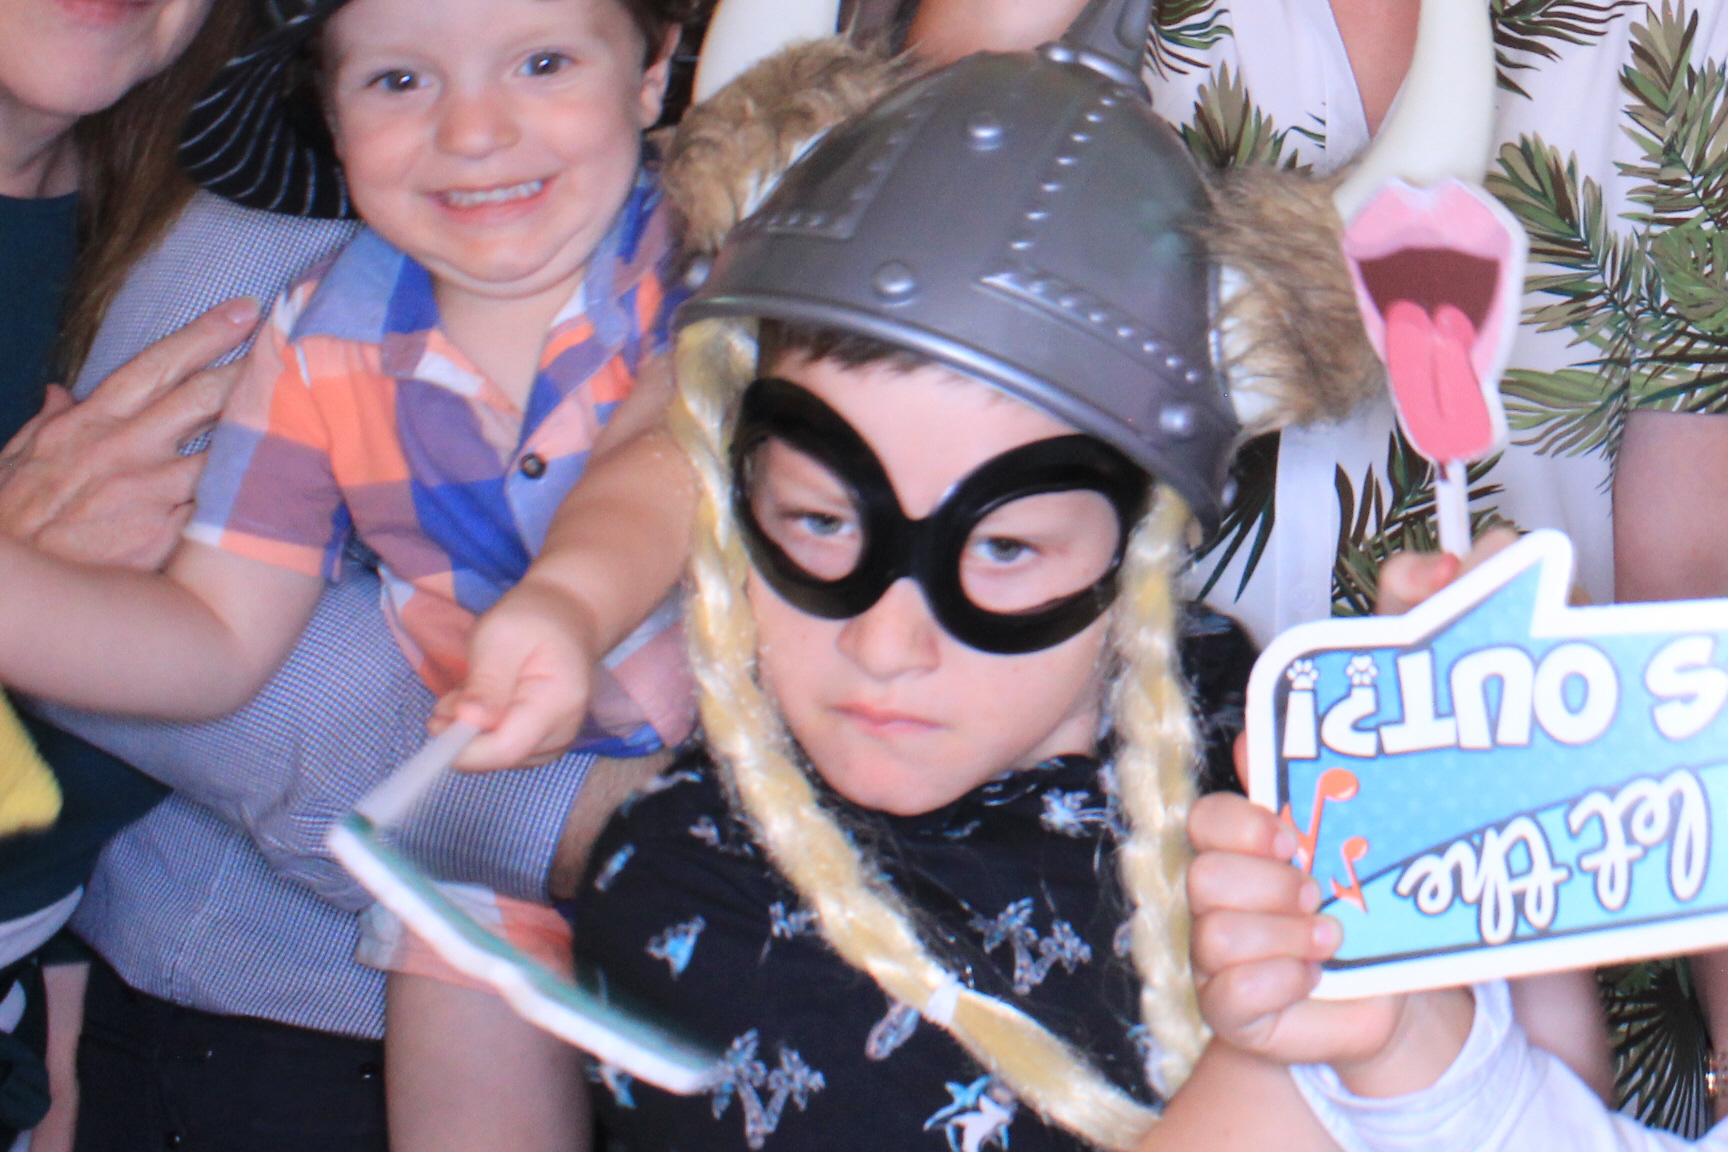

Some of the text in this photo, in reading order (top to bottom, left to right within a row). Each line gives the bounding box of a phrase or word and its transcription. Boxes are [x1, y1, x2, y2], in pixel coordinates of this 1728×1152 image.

[1282, 645, 1618, 759] OUT?!
[1397, 822, 1569, 944] the
[1570, 771, 1708, 910] let
